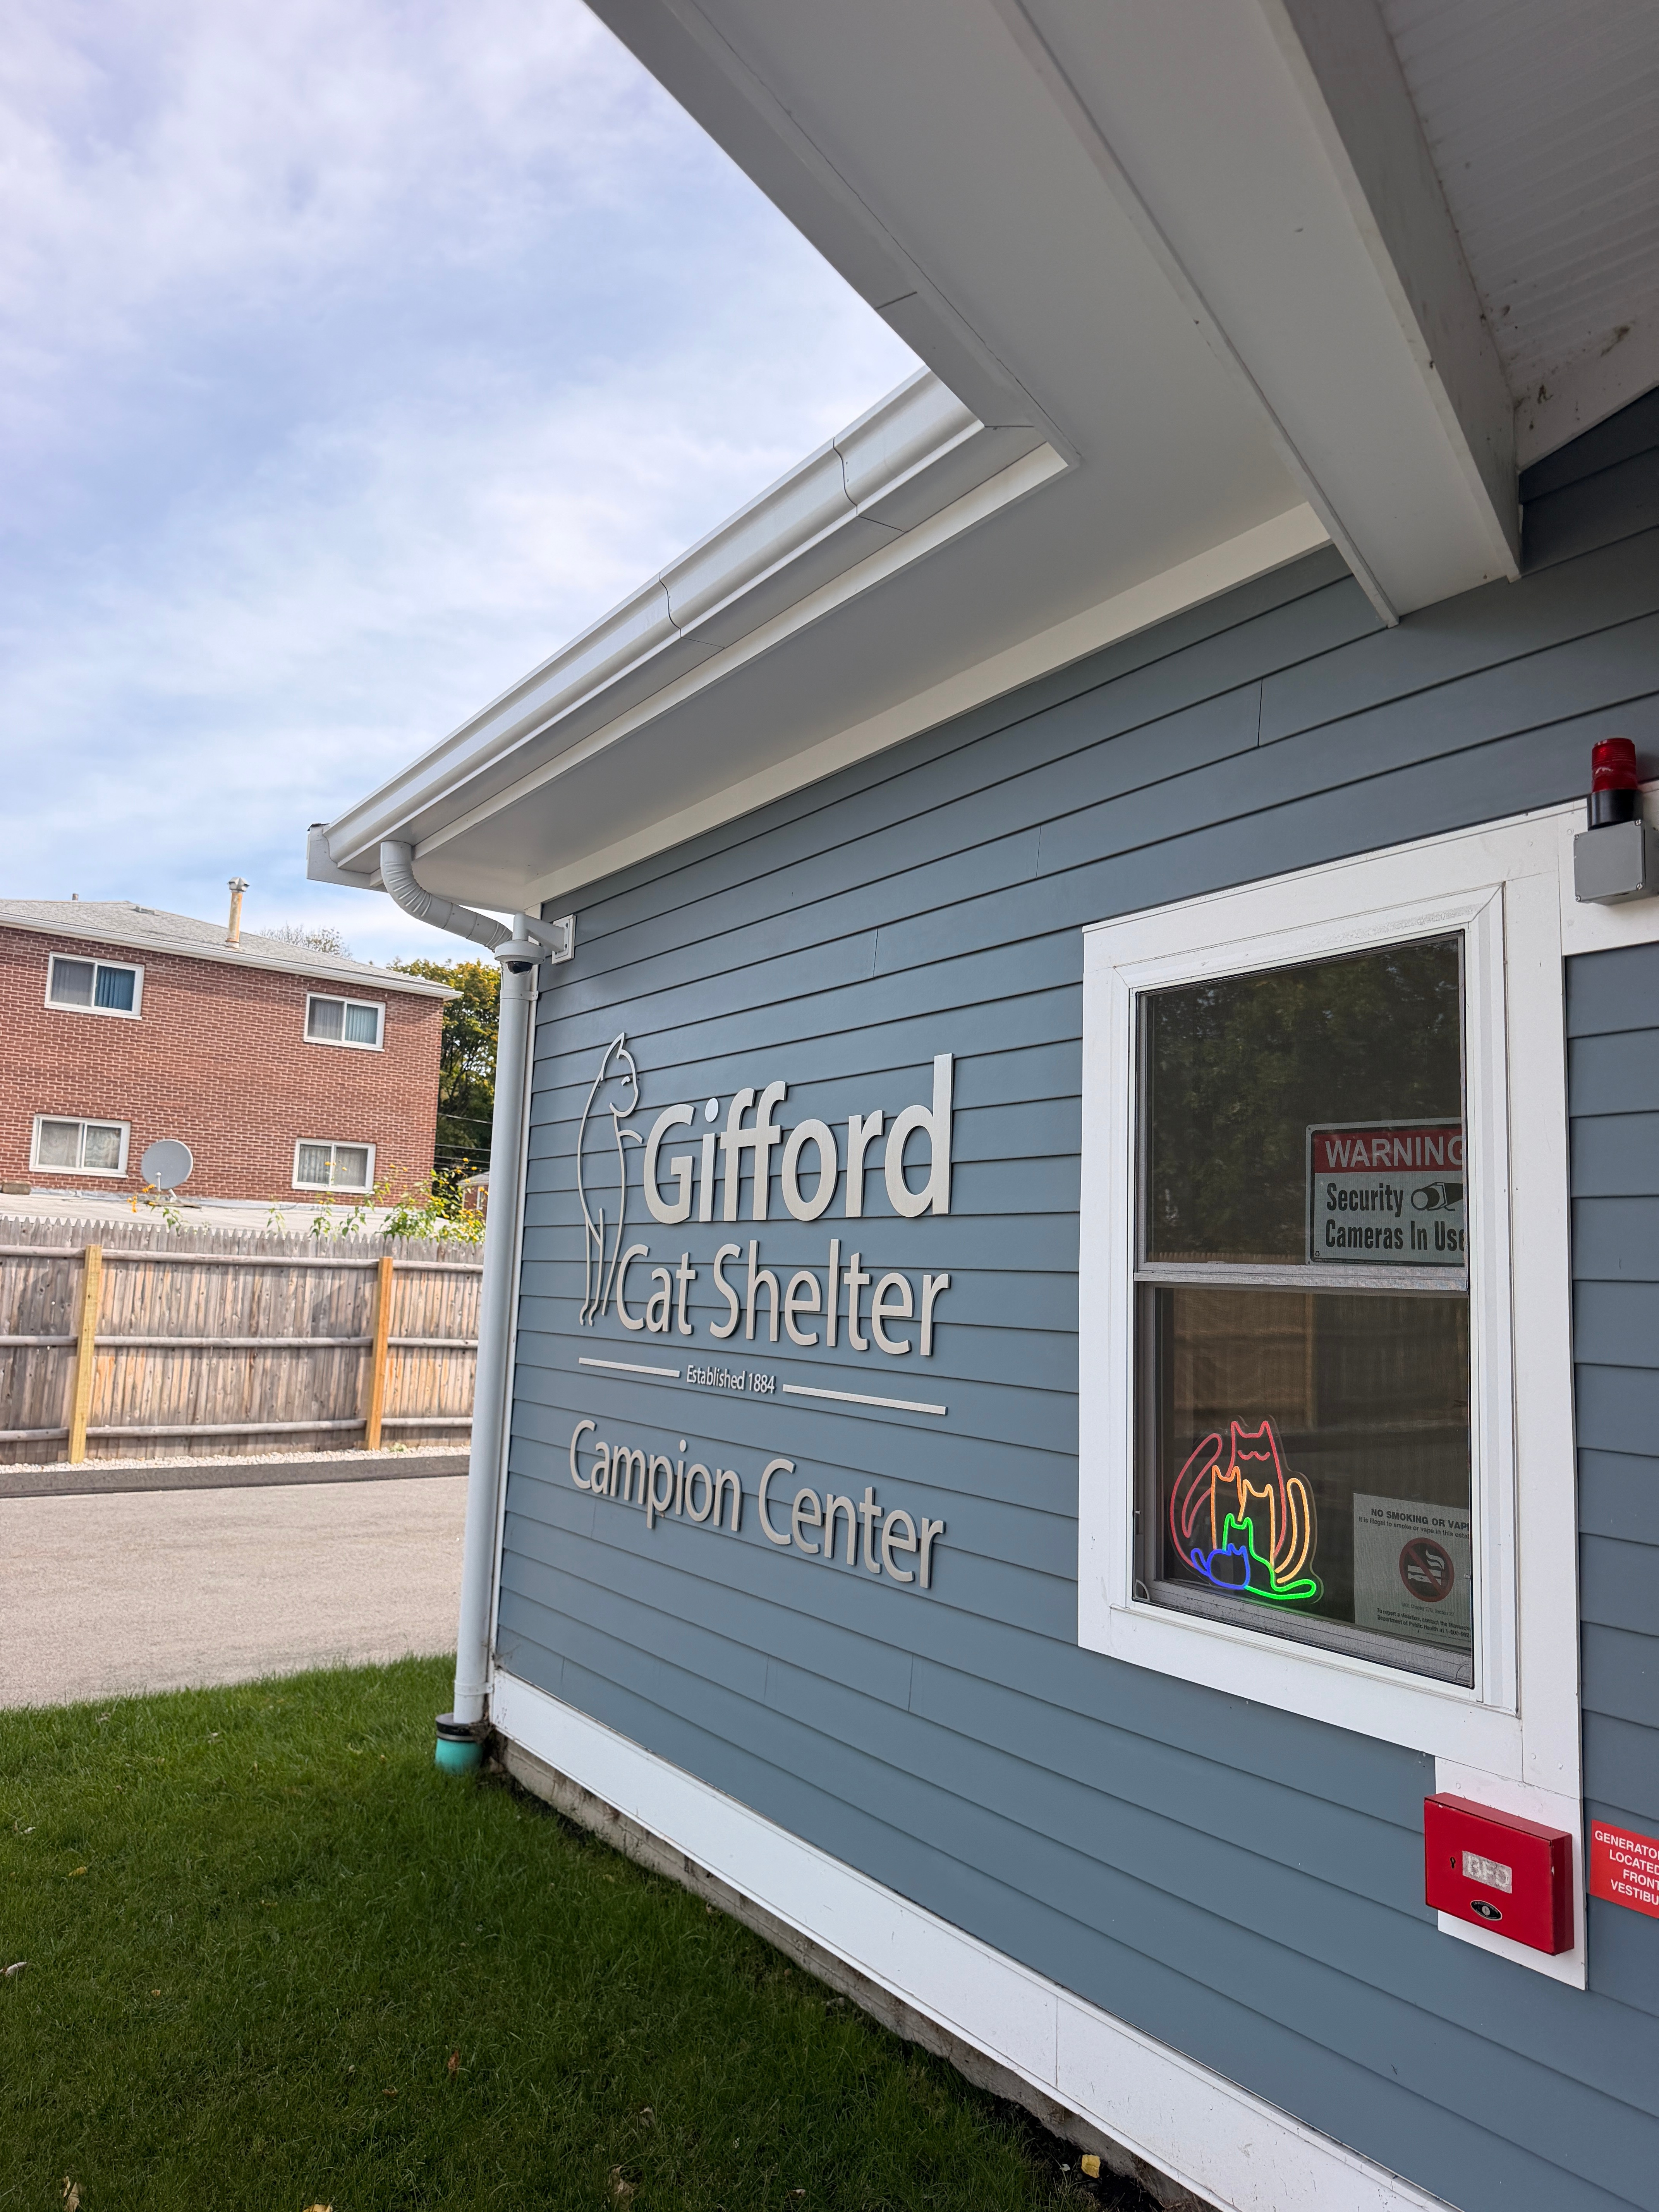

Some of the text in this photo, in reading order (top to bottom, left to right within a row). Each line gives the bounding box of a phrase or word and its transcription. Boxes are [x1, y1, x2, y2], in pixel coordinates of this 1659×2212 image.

[644, 1053, 953, 1224] Gifford
[1325, 1135, 1463, 1168] WARNING
[1326, 1182, 1403, 1218] Security
[1326, 1219, 1403, 1250] Cameras
[1410, 1220, 1428, 1250] In
[616, 1239, 951, 1356] Cat Shelter
[686, 1364, 775, 1394] Established 1884
[570, 1419, 946, 1589] Campion Center
[1371, 1508, 1384, 1517] NO
[1386, 1511, 1428, 1525] SMOKING
[1431, 1518, 1445, 1527] OR
[1370, 1518, 1385, 1526] illegal
[1377, 1614, 1402, 1625] Department
[1594, 1830, 1659, 1860] GENERATO
[1609, 1849, 1659, 1875] LOCATED
[1611, 1879, 1659, 1905] VESTIBU
